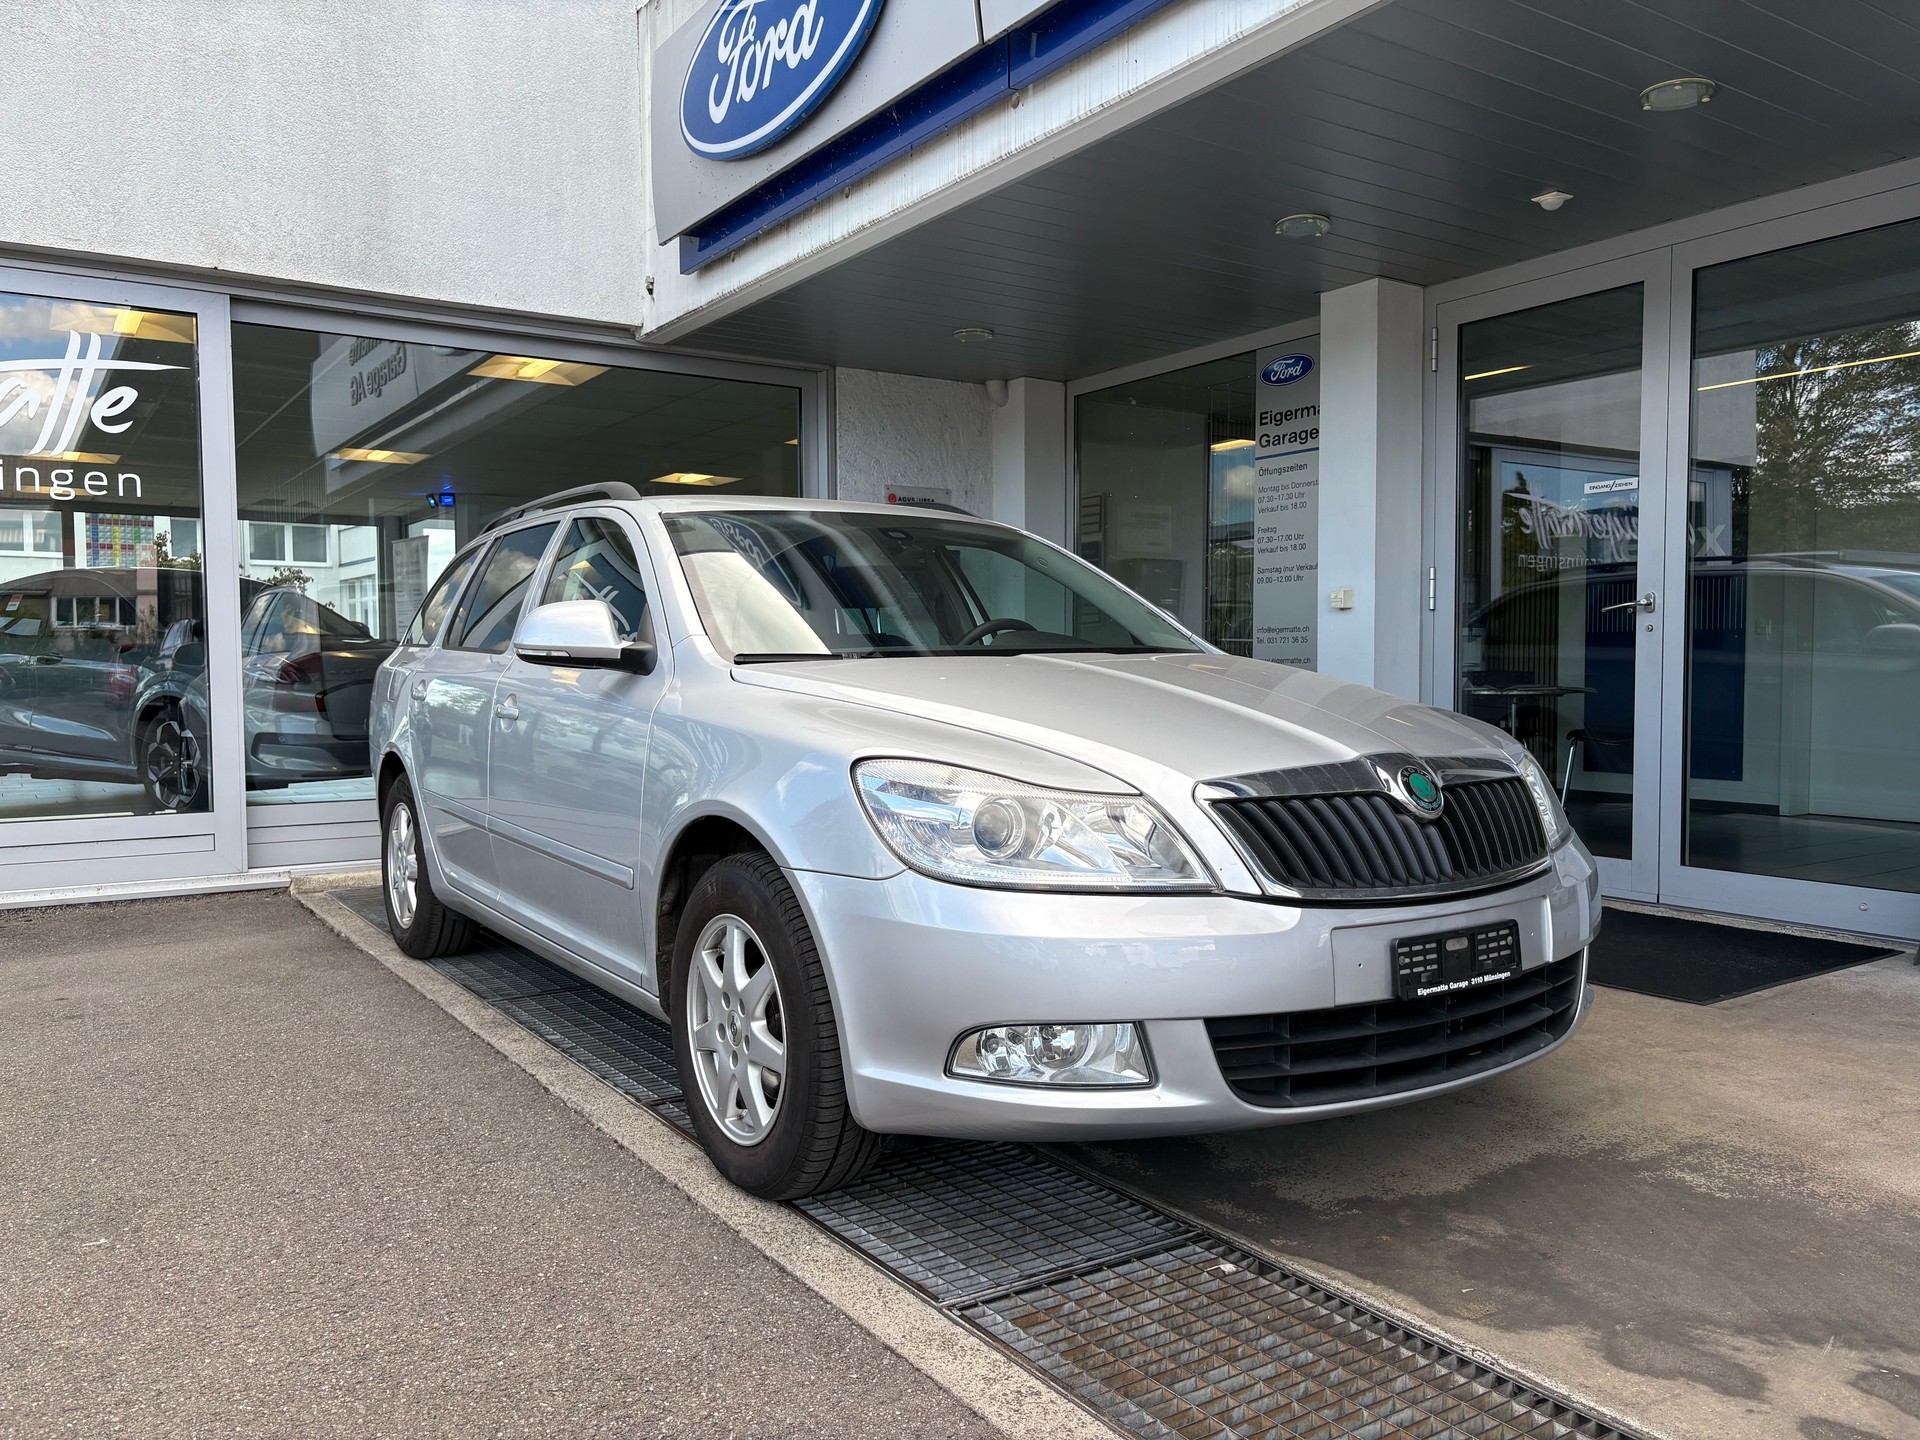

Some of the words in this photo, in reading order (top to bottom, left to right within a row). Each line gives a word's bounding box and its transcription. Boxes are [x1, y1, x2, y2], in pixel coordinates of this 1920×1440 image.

[708, 0, 824, 124] Ford
[1270, 358, 1304, 381] Ford
[1259, 404, 1320, 427] Eigerm
[1258, 427, 1319, 448] Garage
[1291, 480, 1319, 489] Donnerst
[1258, 505, 1279, 513] Verkauf
[1291, 501, 1307, 509] 18.00
[1257, 526, 1277, 534] Freitag
[1257, 546, 1278, 554] Verkauf
[1290, 543, 1307, 551] 18.00
[1256, 626, 1310, 635] info@eigermatte.ch
[1279, 636, 1290, 644] 721
[1417, 984, 1449, 996] Eigermatte
[1449, 980, 1469, 989] Garage
[1483, 971, 1511, 983] Münsingen
